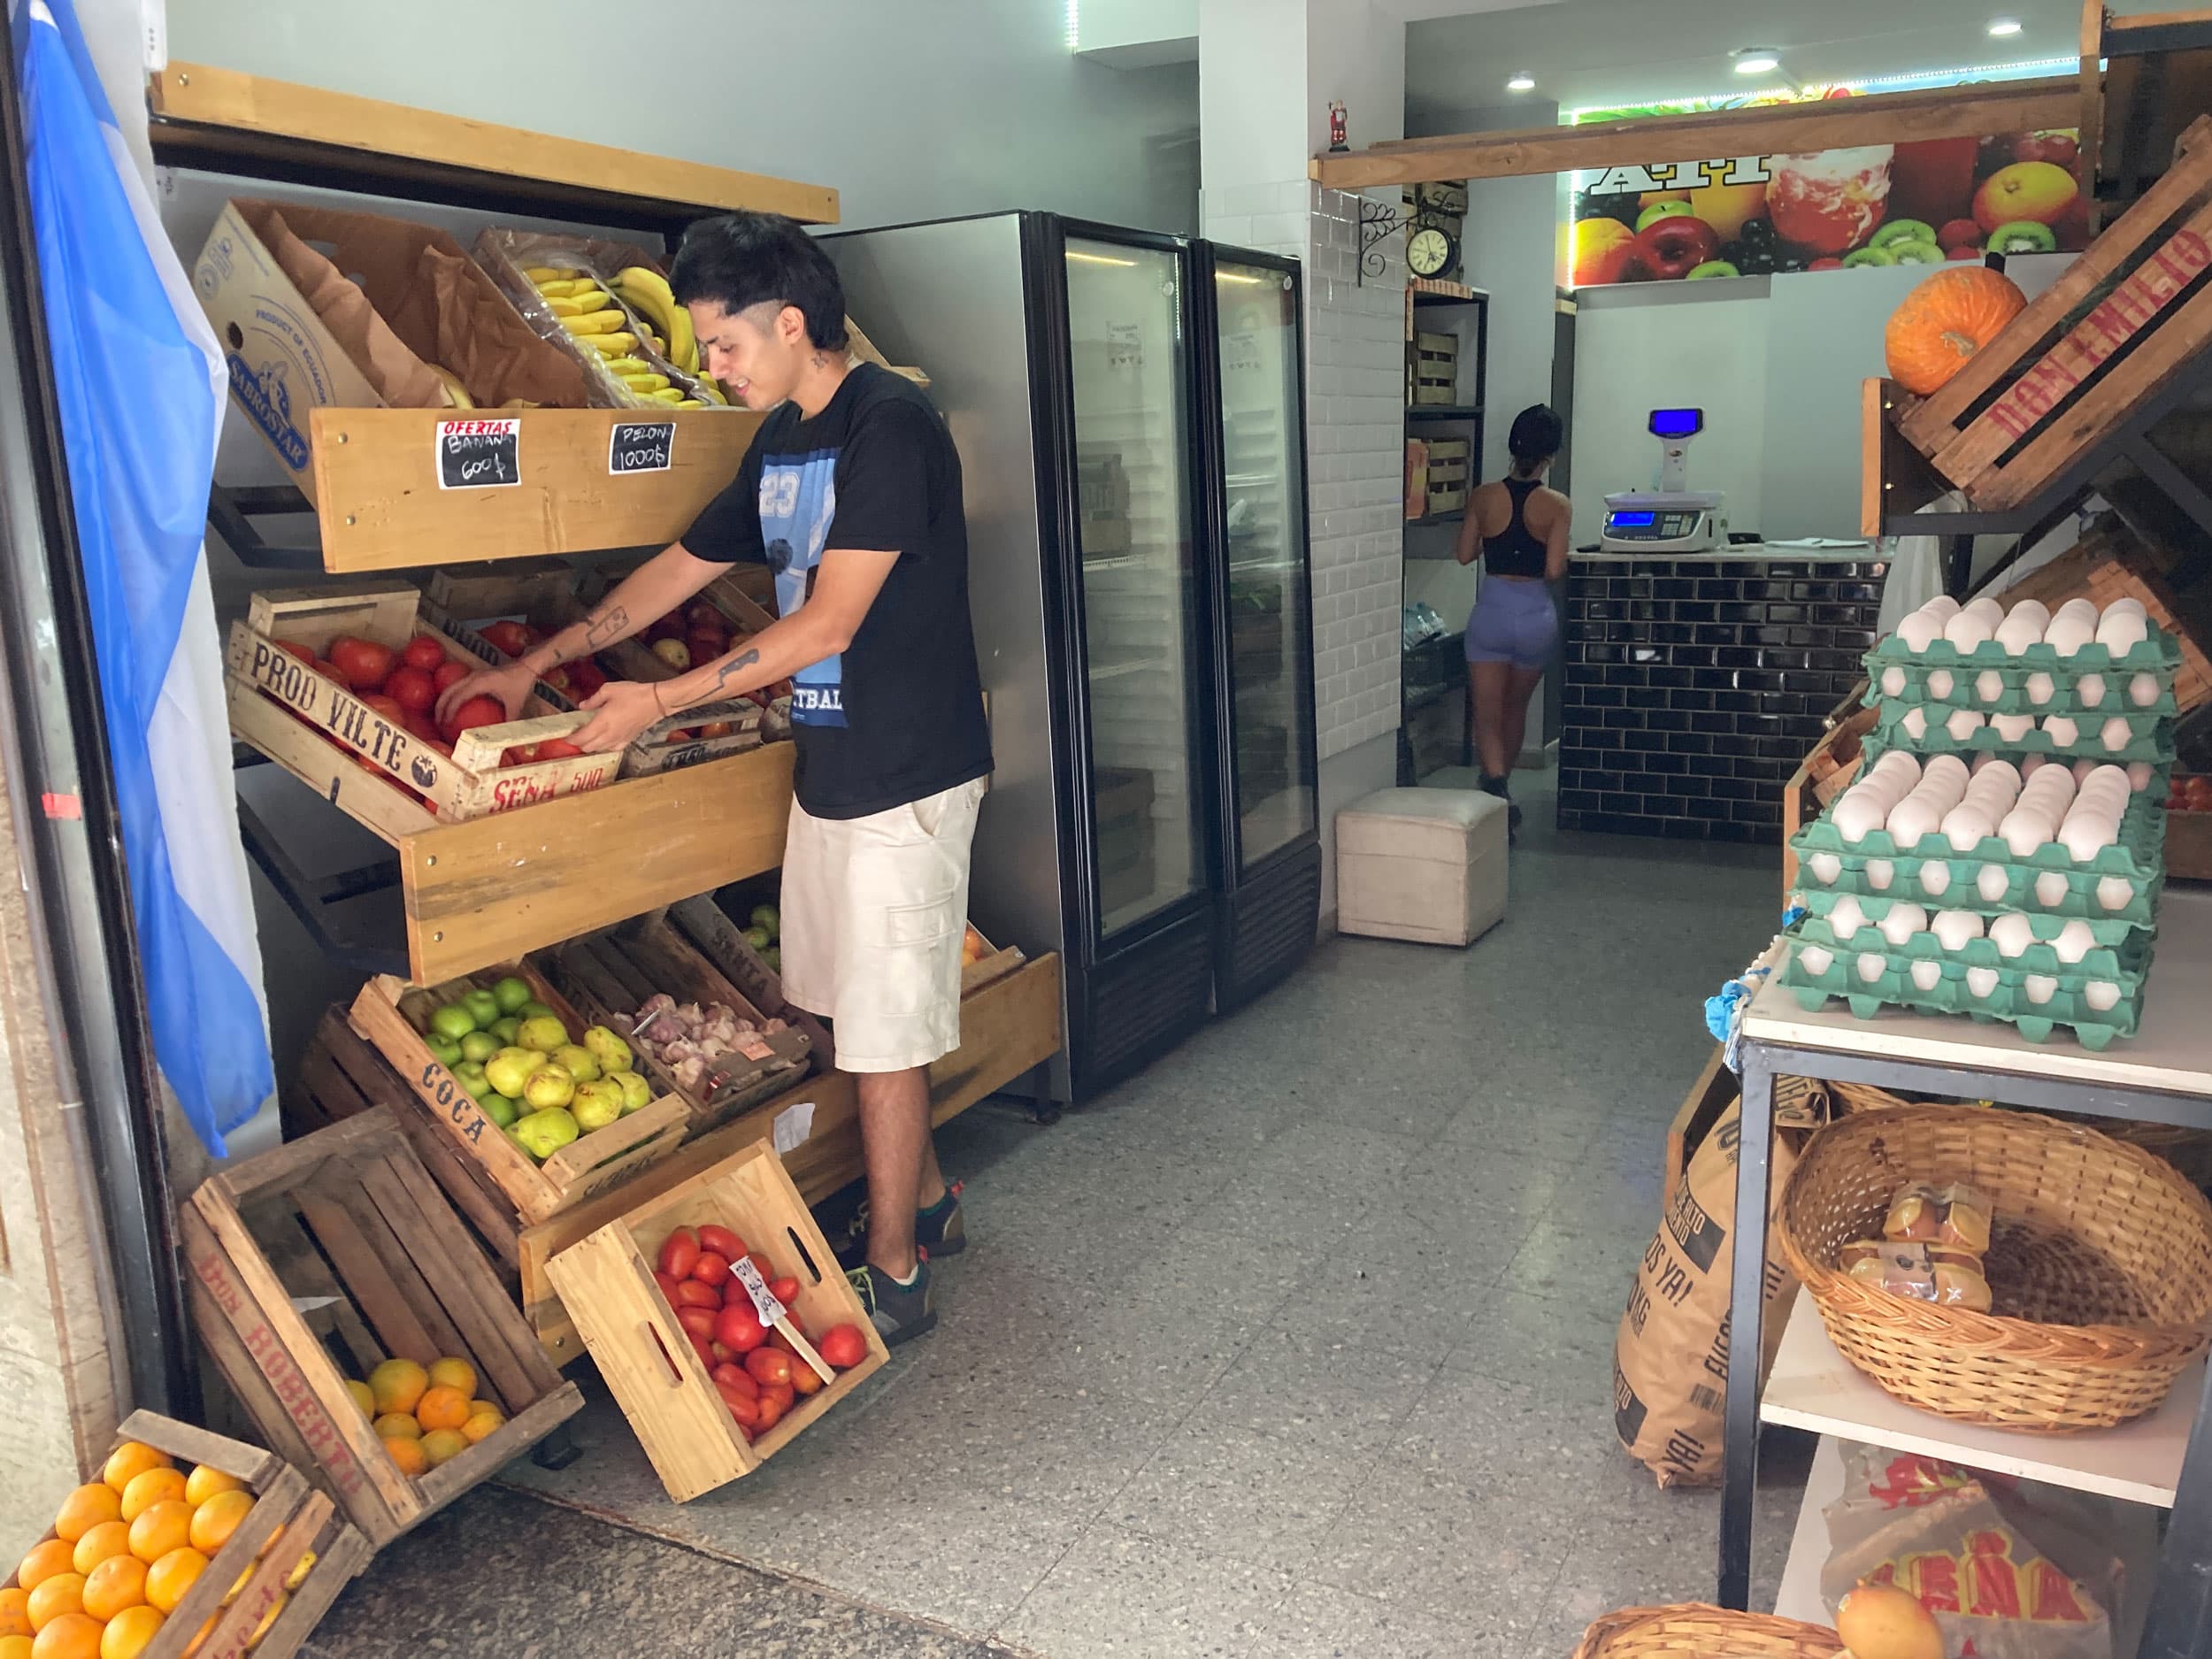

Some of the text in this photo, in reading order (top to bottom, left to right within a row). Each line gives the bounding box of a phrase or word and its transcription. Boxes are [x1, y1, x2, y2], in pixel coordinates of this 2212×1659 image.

[255, 308, 327, 406] PRODUCT OF ECUADOR
[1986, 355, 2080, 440] DON
[229, 358, 306, 465] SABROSTAR
[444, 421, 511, 436] OFERTAS
[759, 472, 801, 518] 23
[250, 641, 407, 772] PROD VILTE
[422, 1063, 487, 1146] COCA
[1683, 1197, 1706, 1236] ALTO
[1655, 1256, 1694, 1308] YA!
[244, 1325, 364, 1495] ROBERTO
[1662, 1428, 1706, 1472] YA!
